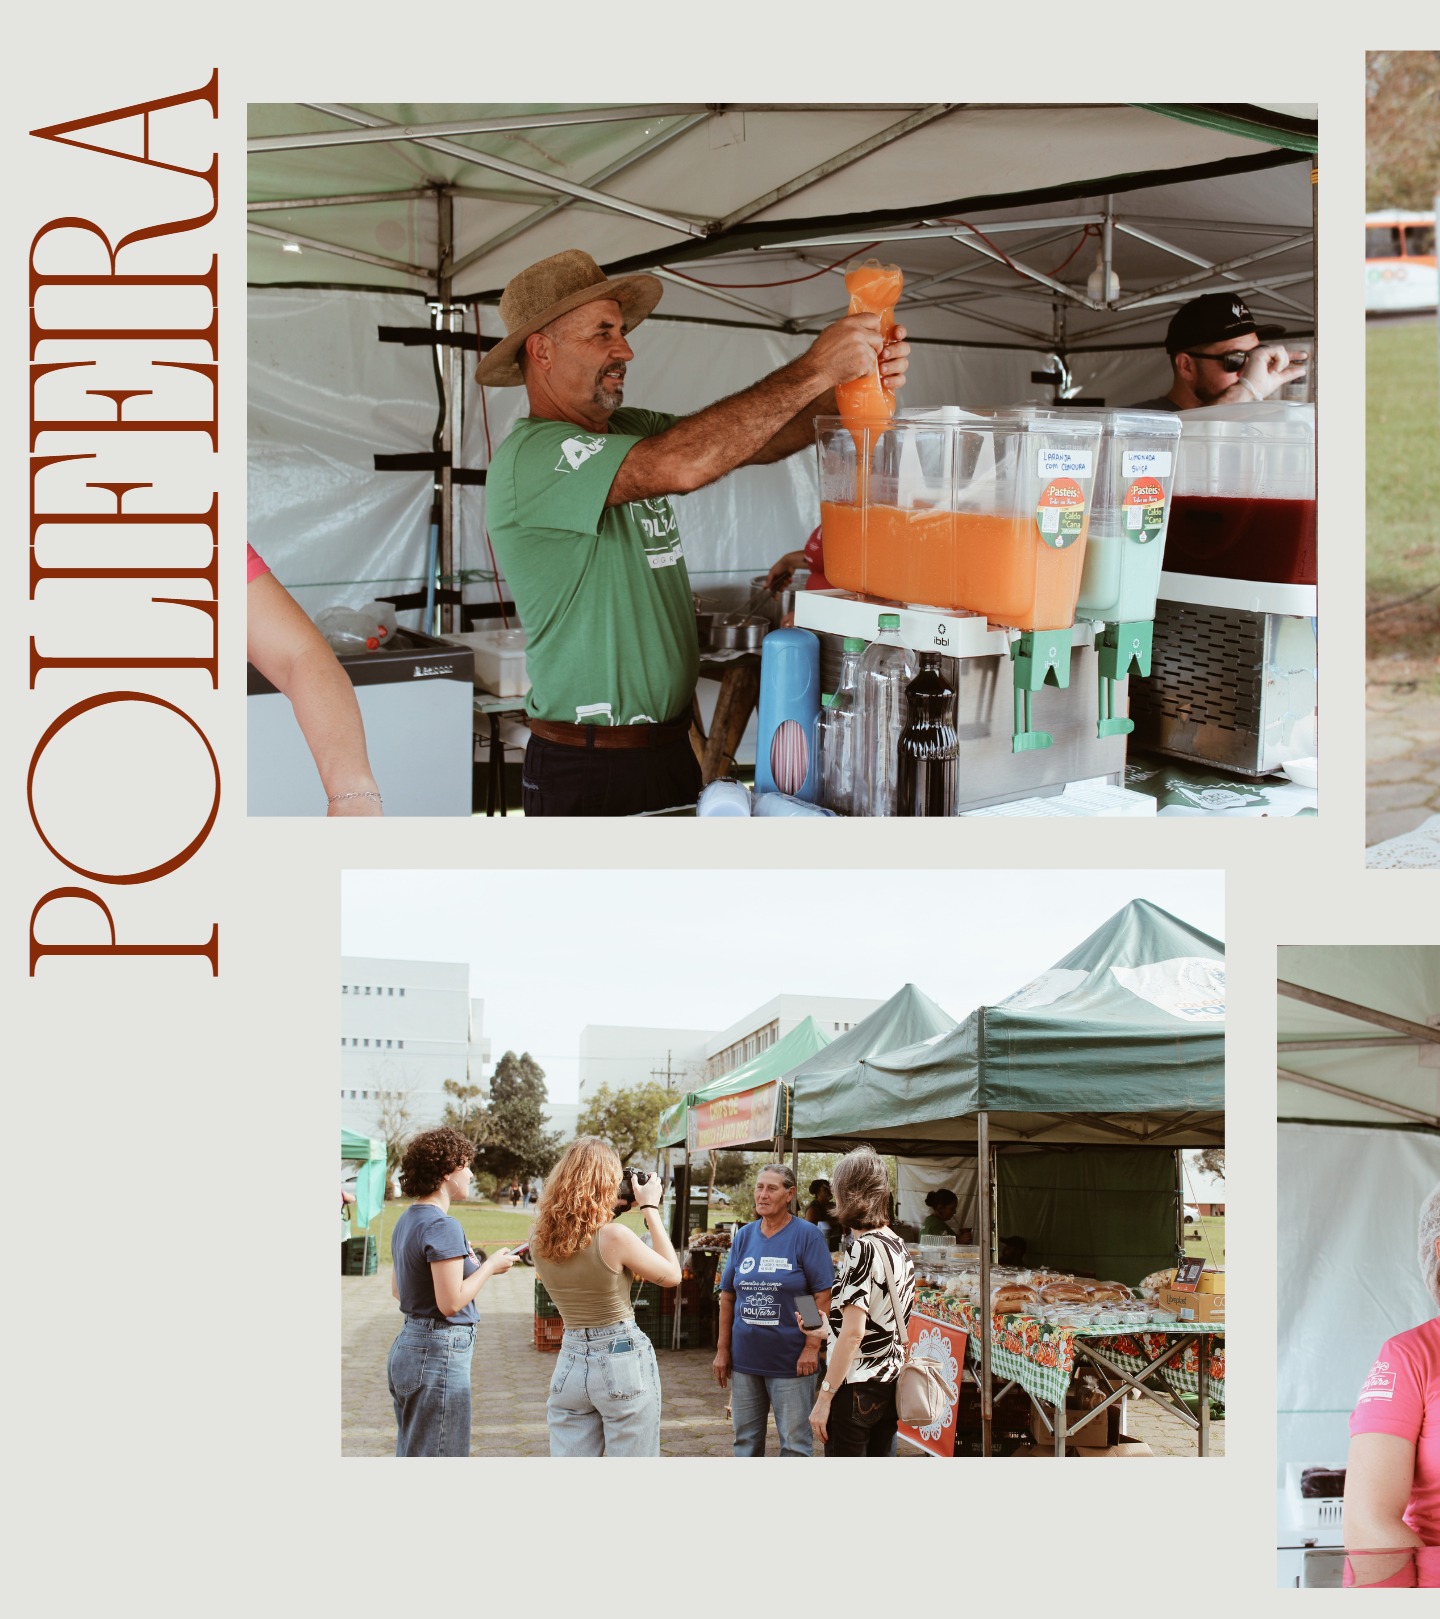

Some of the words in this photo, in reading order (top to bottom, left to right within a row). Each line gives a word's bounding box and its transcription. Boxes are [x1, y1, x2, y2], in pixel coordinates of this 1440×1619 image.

[1050, 485, 1077, 498] Pastéis
[1133, 484, 1158, 495] Pastéis
[1064, 512, 1081, 520] Caldo
[1147, 508, 1162, 516] Caldo
[1149, 516, 1162, 524] Cana
[933, 636, 949, 646] ibbl
